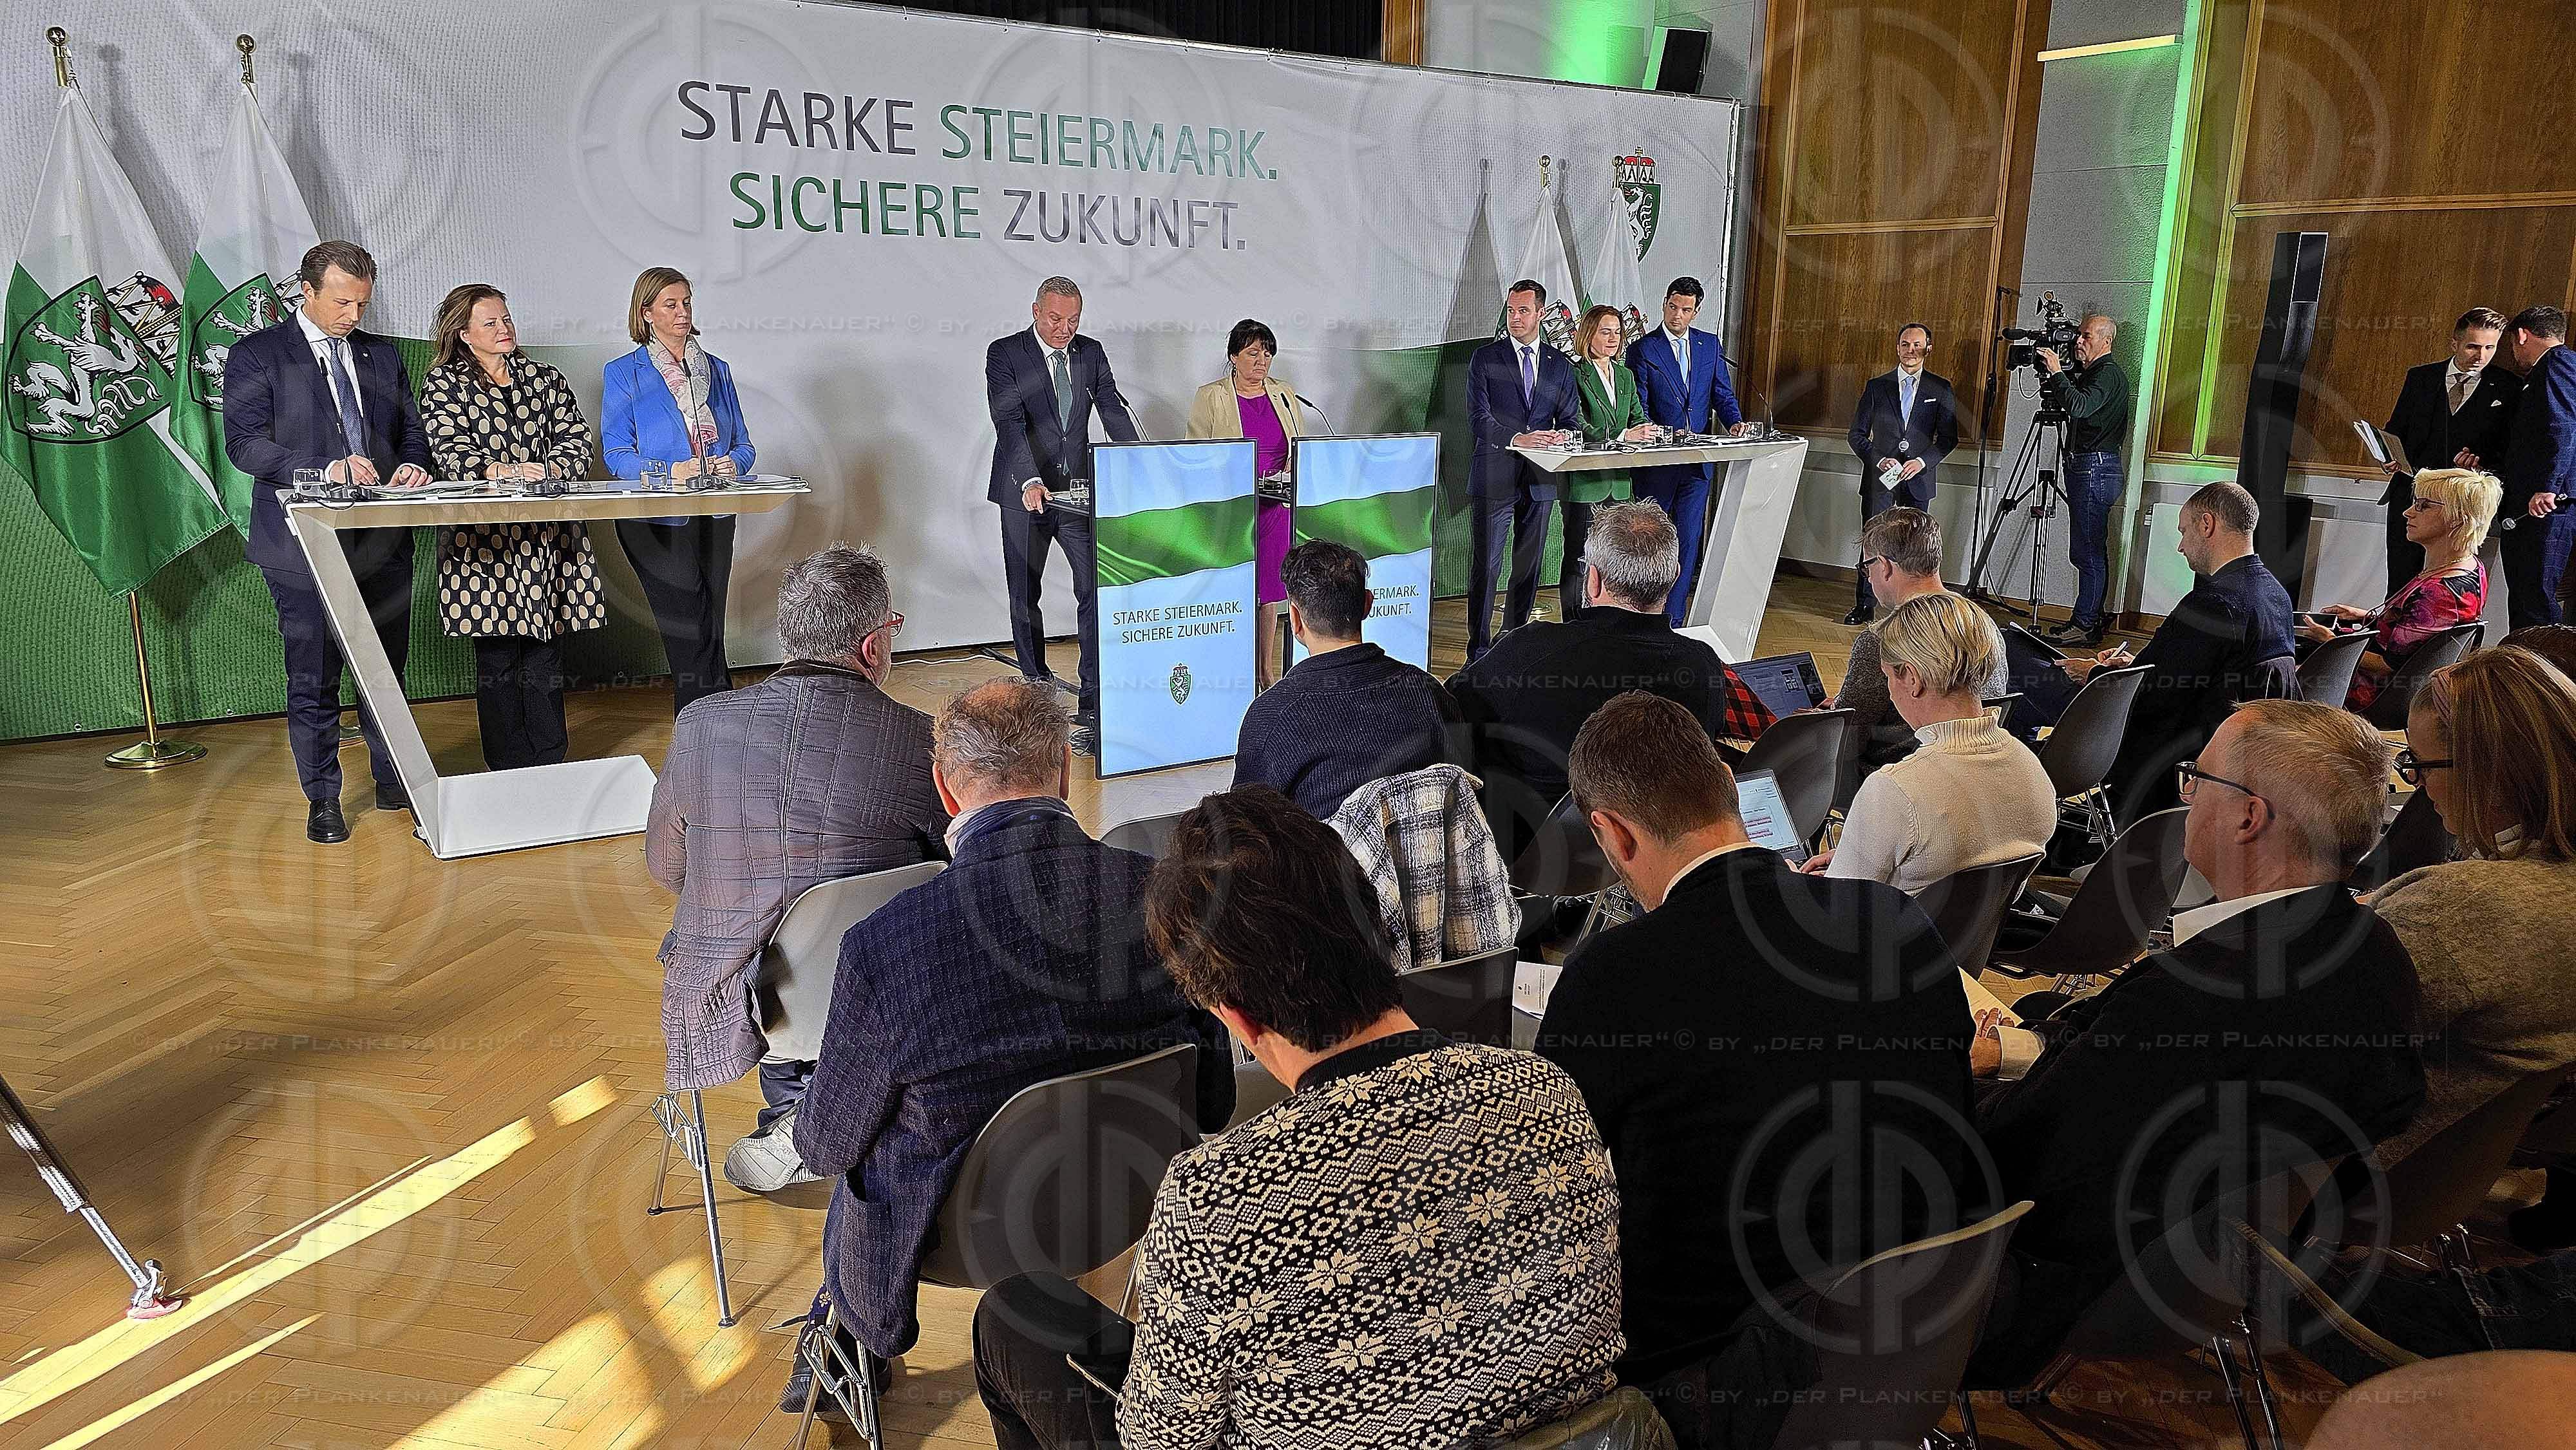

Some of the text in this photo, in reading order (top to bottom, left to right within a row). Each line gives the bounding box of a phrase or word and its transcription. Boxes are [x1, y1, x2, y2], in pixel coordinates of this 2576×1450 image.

[678, 80, 1278, 180] STARKE STEIERMARK.
[730, 172, 1247, 250] SICHERE ZUKUNFT.
[1113, 601, 1242, 625] STARKE STEIERMARK.
[1122, 620, 1235, 644] SICHERE ZUKUNFT.
